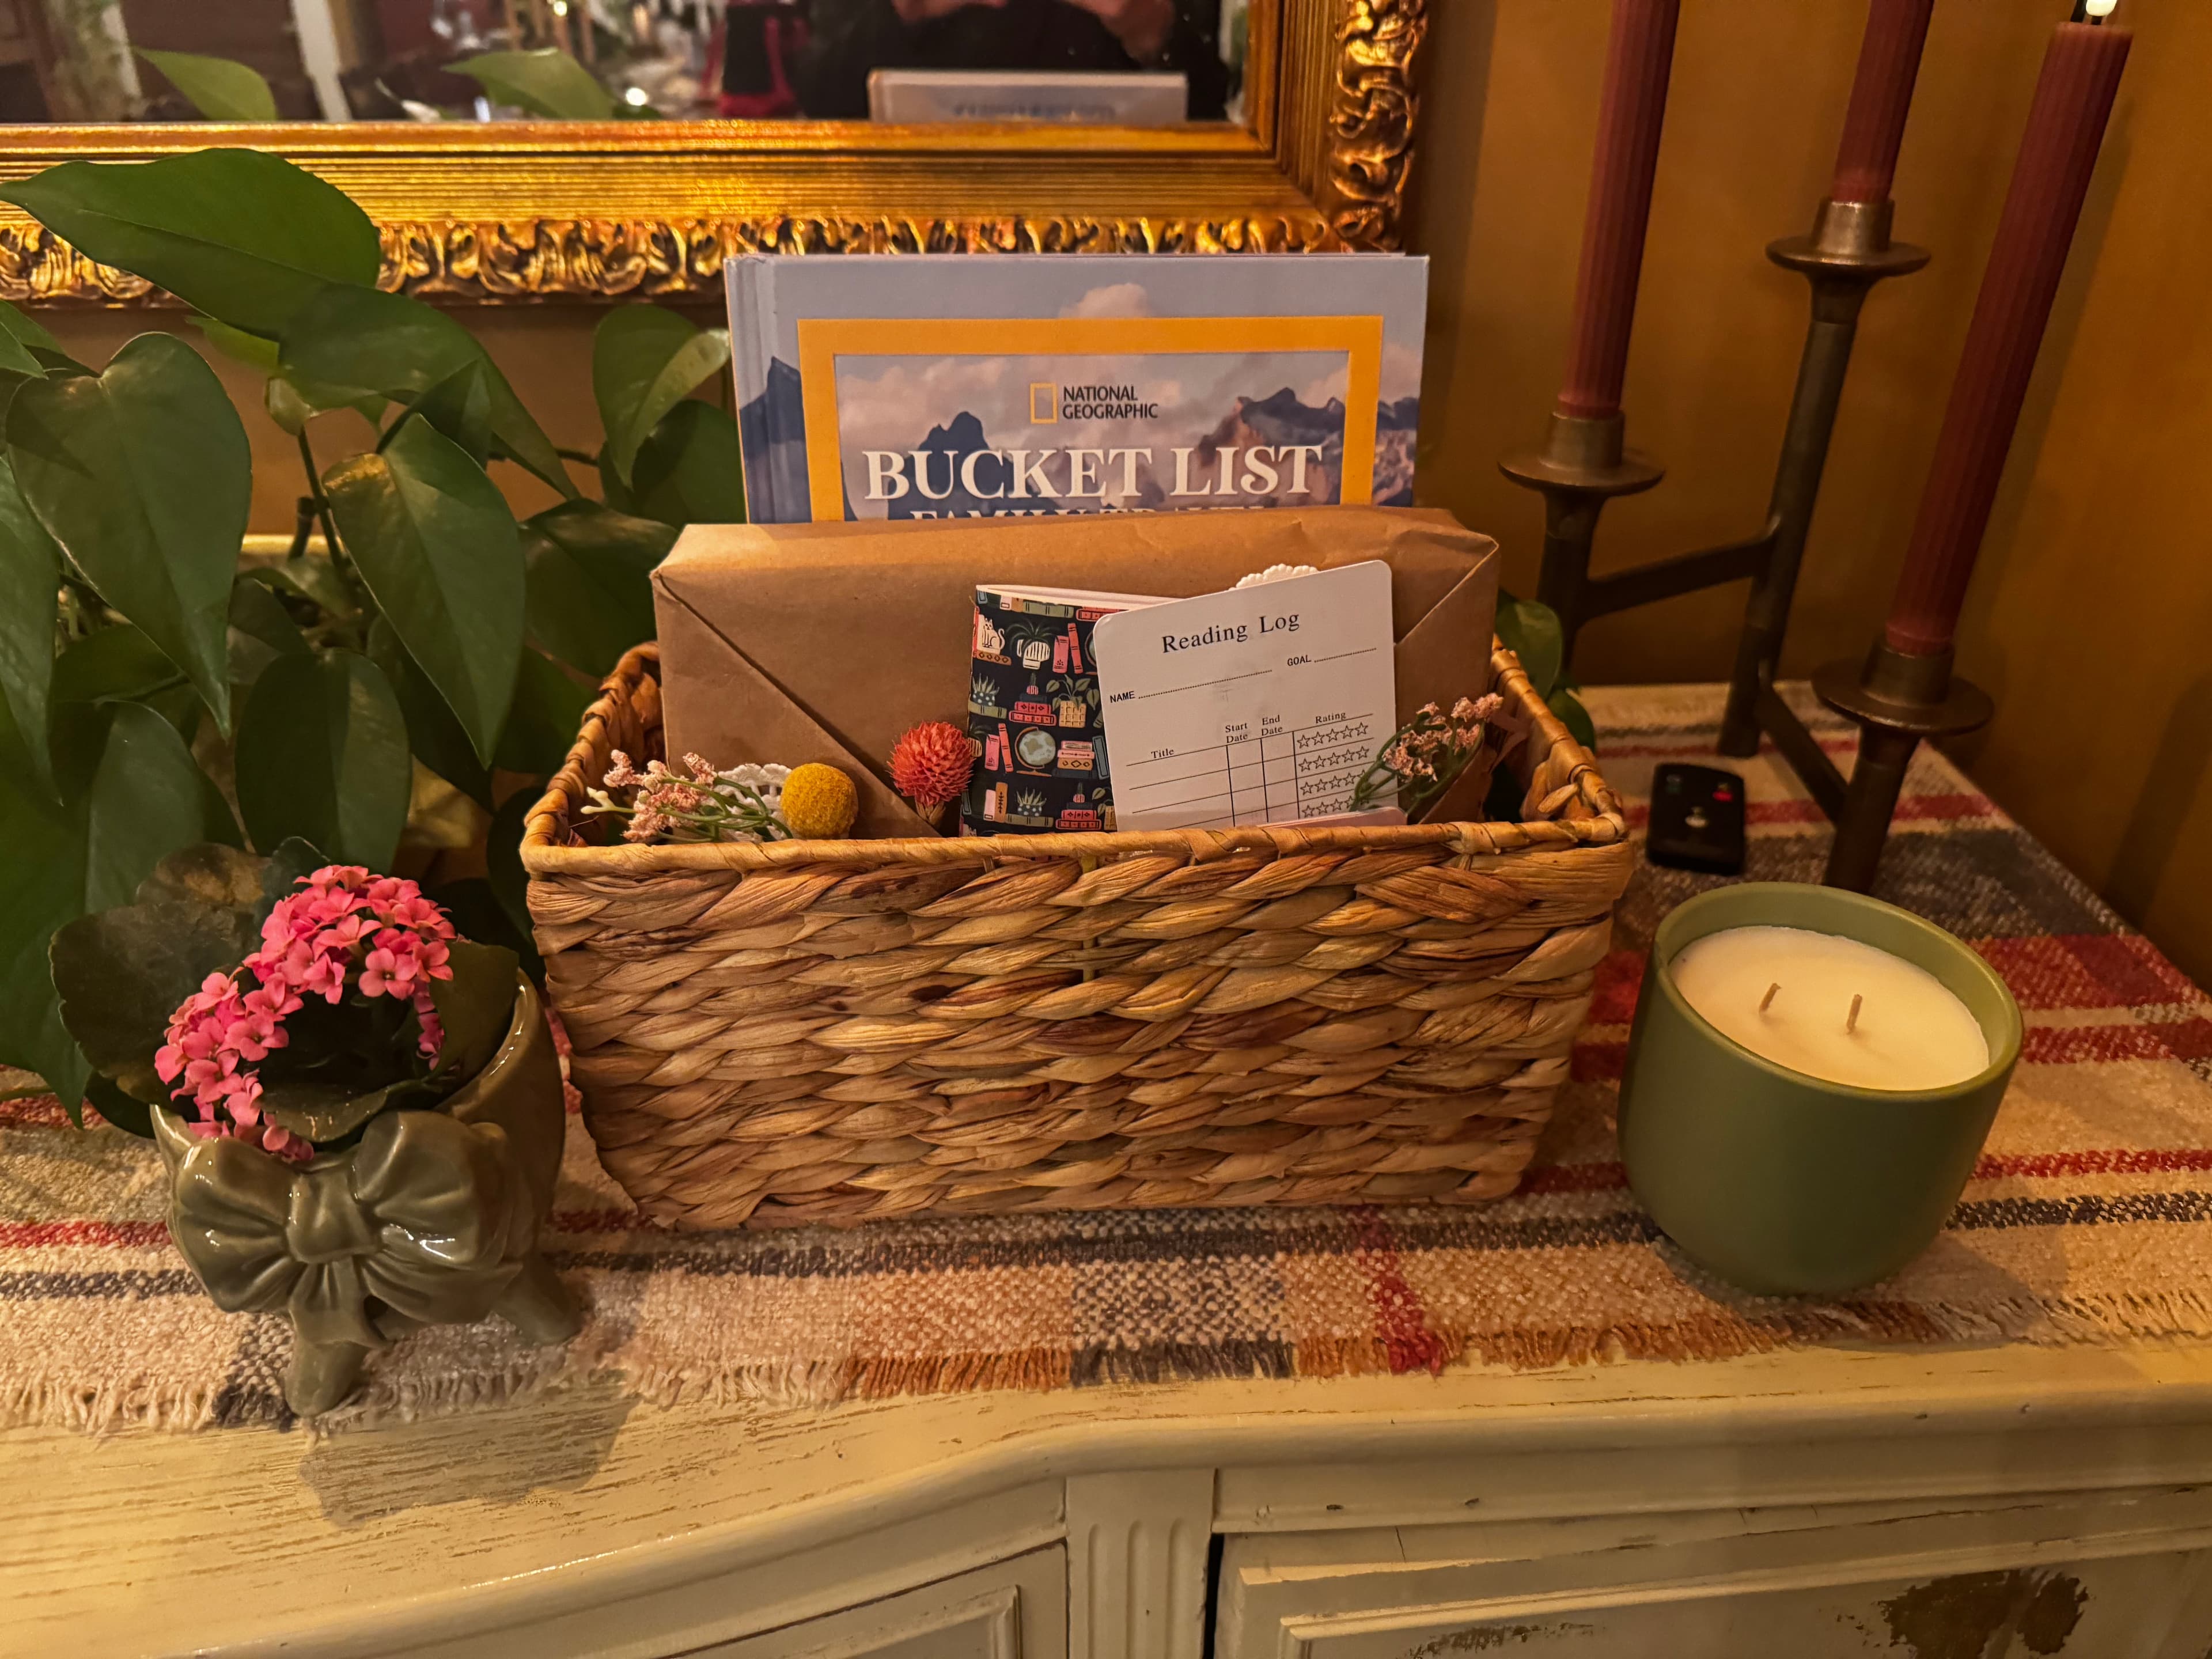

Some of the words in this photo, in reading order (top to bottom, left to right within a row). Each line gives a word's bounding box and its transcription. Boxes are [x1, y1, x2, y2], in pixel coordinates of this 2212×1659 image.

[1063, 385, 1138, 402] NATIONAL
[1063, 403, 1158, 419] GEOGRAPHIC
[862, 449, 1152, 499] BUCKET
[1171, 445, 1323, 497] LIST
[1161, 624, 1248, 653] Reading
[1259, 613, 1300, 633] Log
[1287, 655, 1312, 666] GOAL
[1109, 691, 1135, 703] NAME
[1262, 714, 1280, 726] End
[1315, 712, 1346, 724] Rating
[1225, 722, 1248, 733] Start
[1261, 726, 1283, 737] Date
[1226, 733, 1248, 744] Date
[1150, 747, 1175, 758] Title
